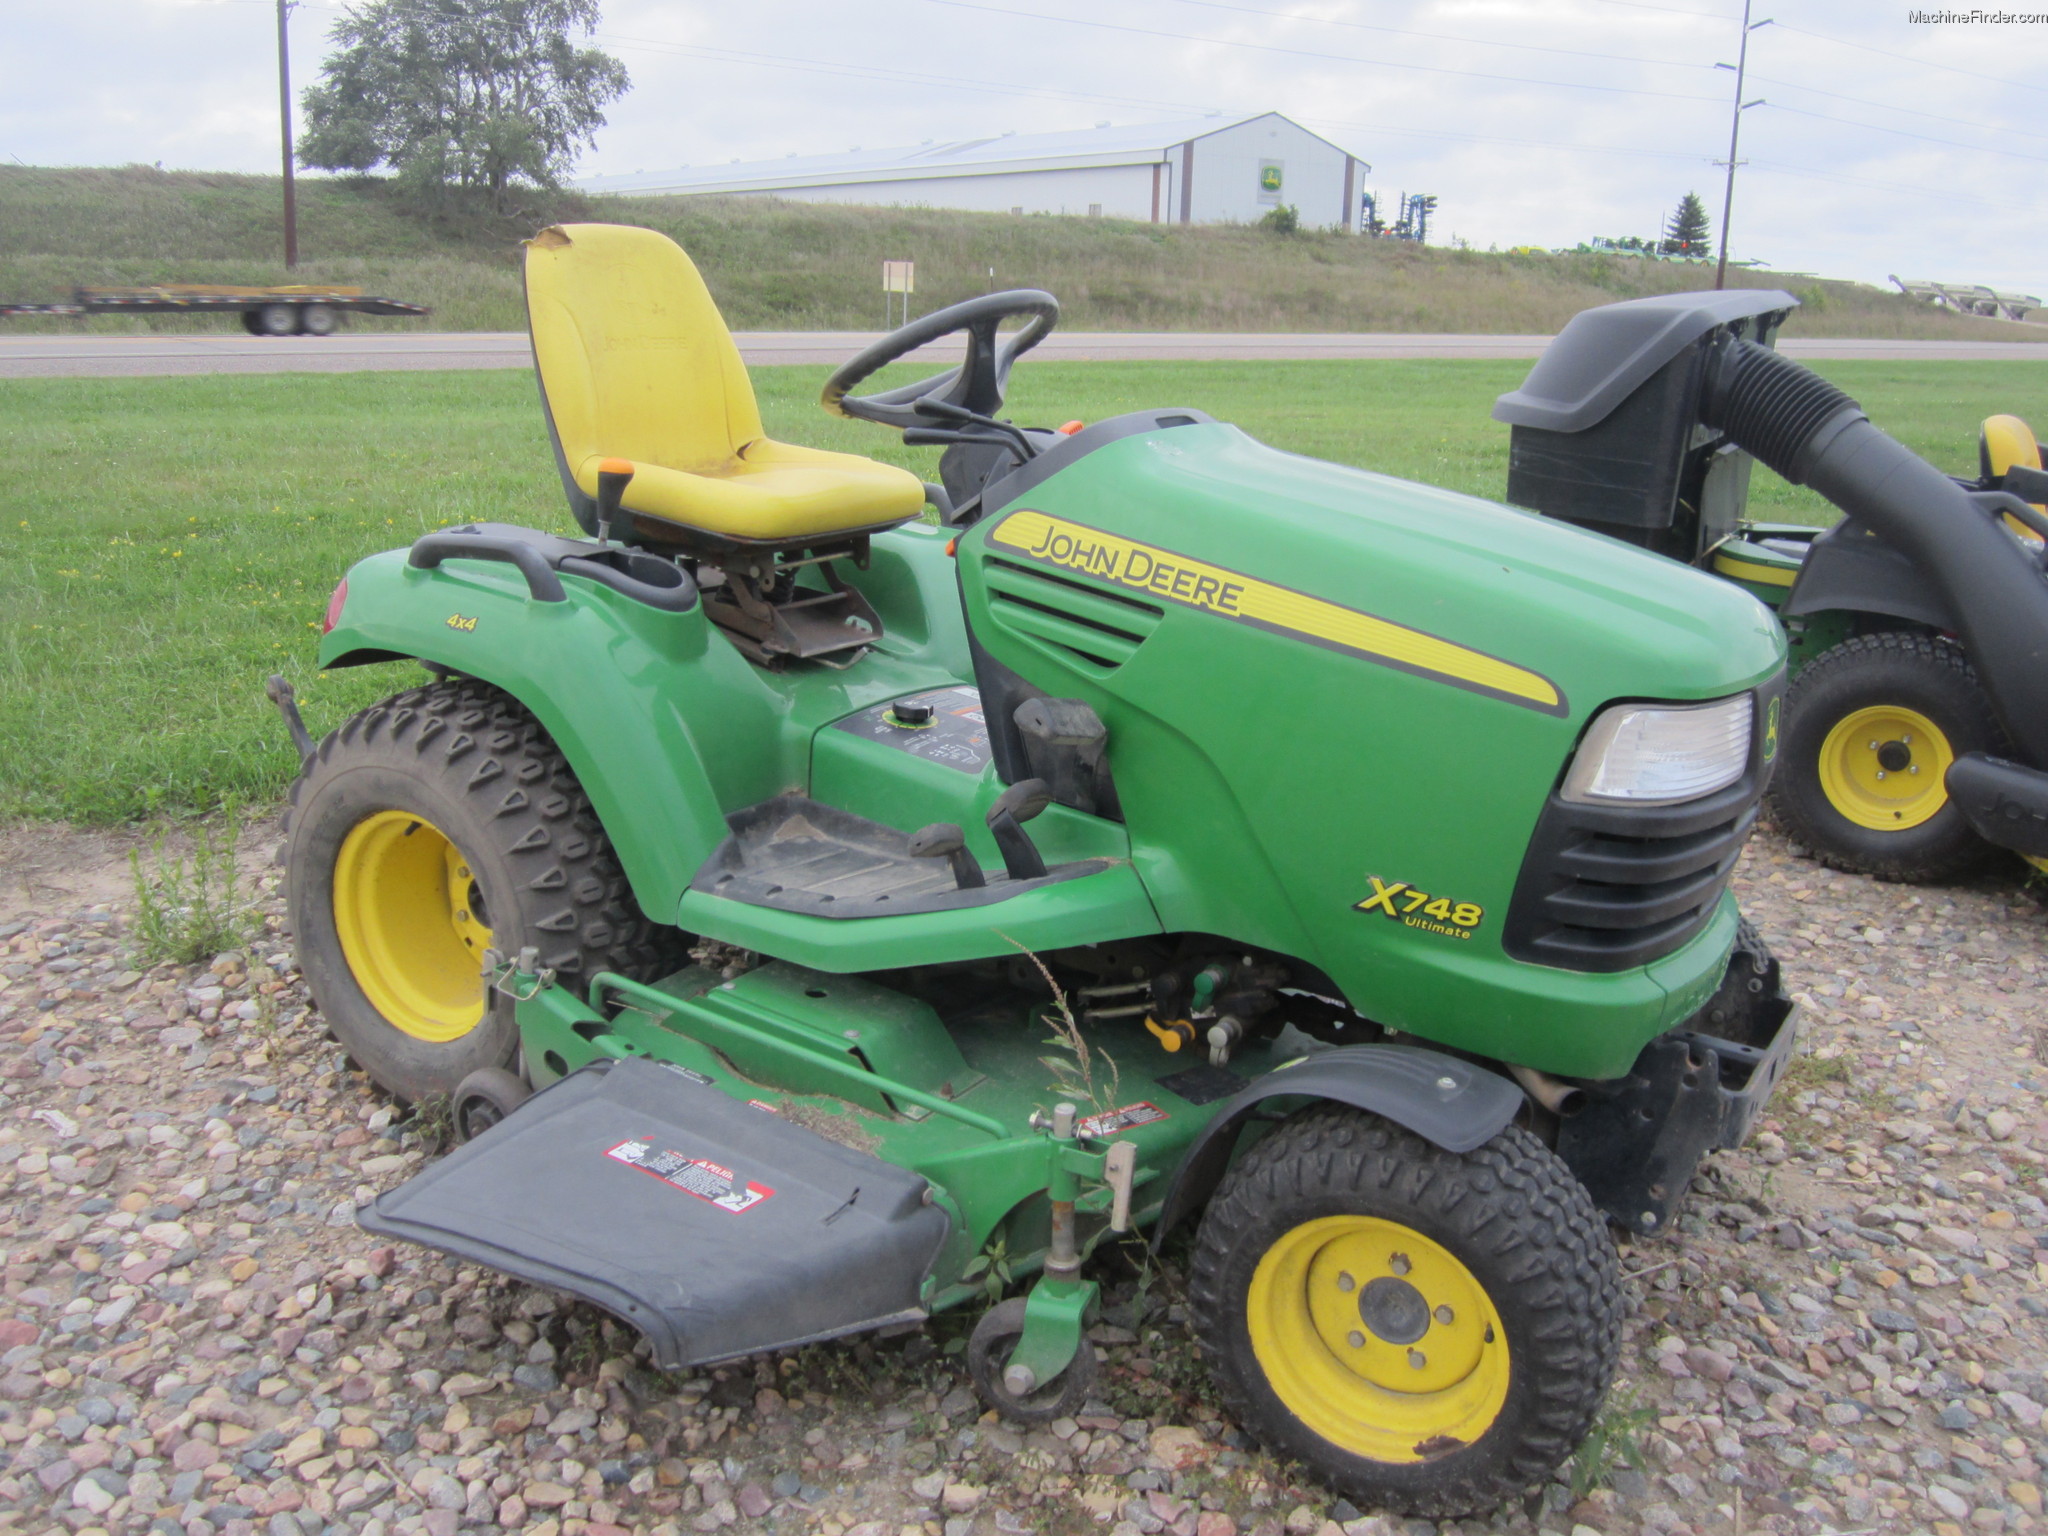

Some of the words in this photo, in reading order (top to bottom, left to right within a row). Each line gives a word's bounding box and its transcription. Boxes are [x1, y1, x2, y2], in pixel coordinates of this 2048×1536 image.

[1031, 525, 1120, 575] JOHN
[1123, 548, 1245, 612] DEERE
[446, 613, 478, 632] 4x4
[1356, 875, 1483, 928] X748
[1405, 916, 1471, 939] Ultimate
